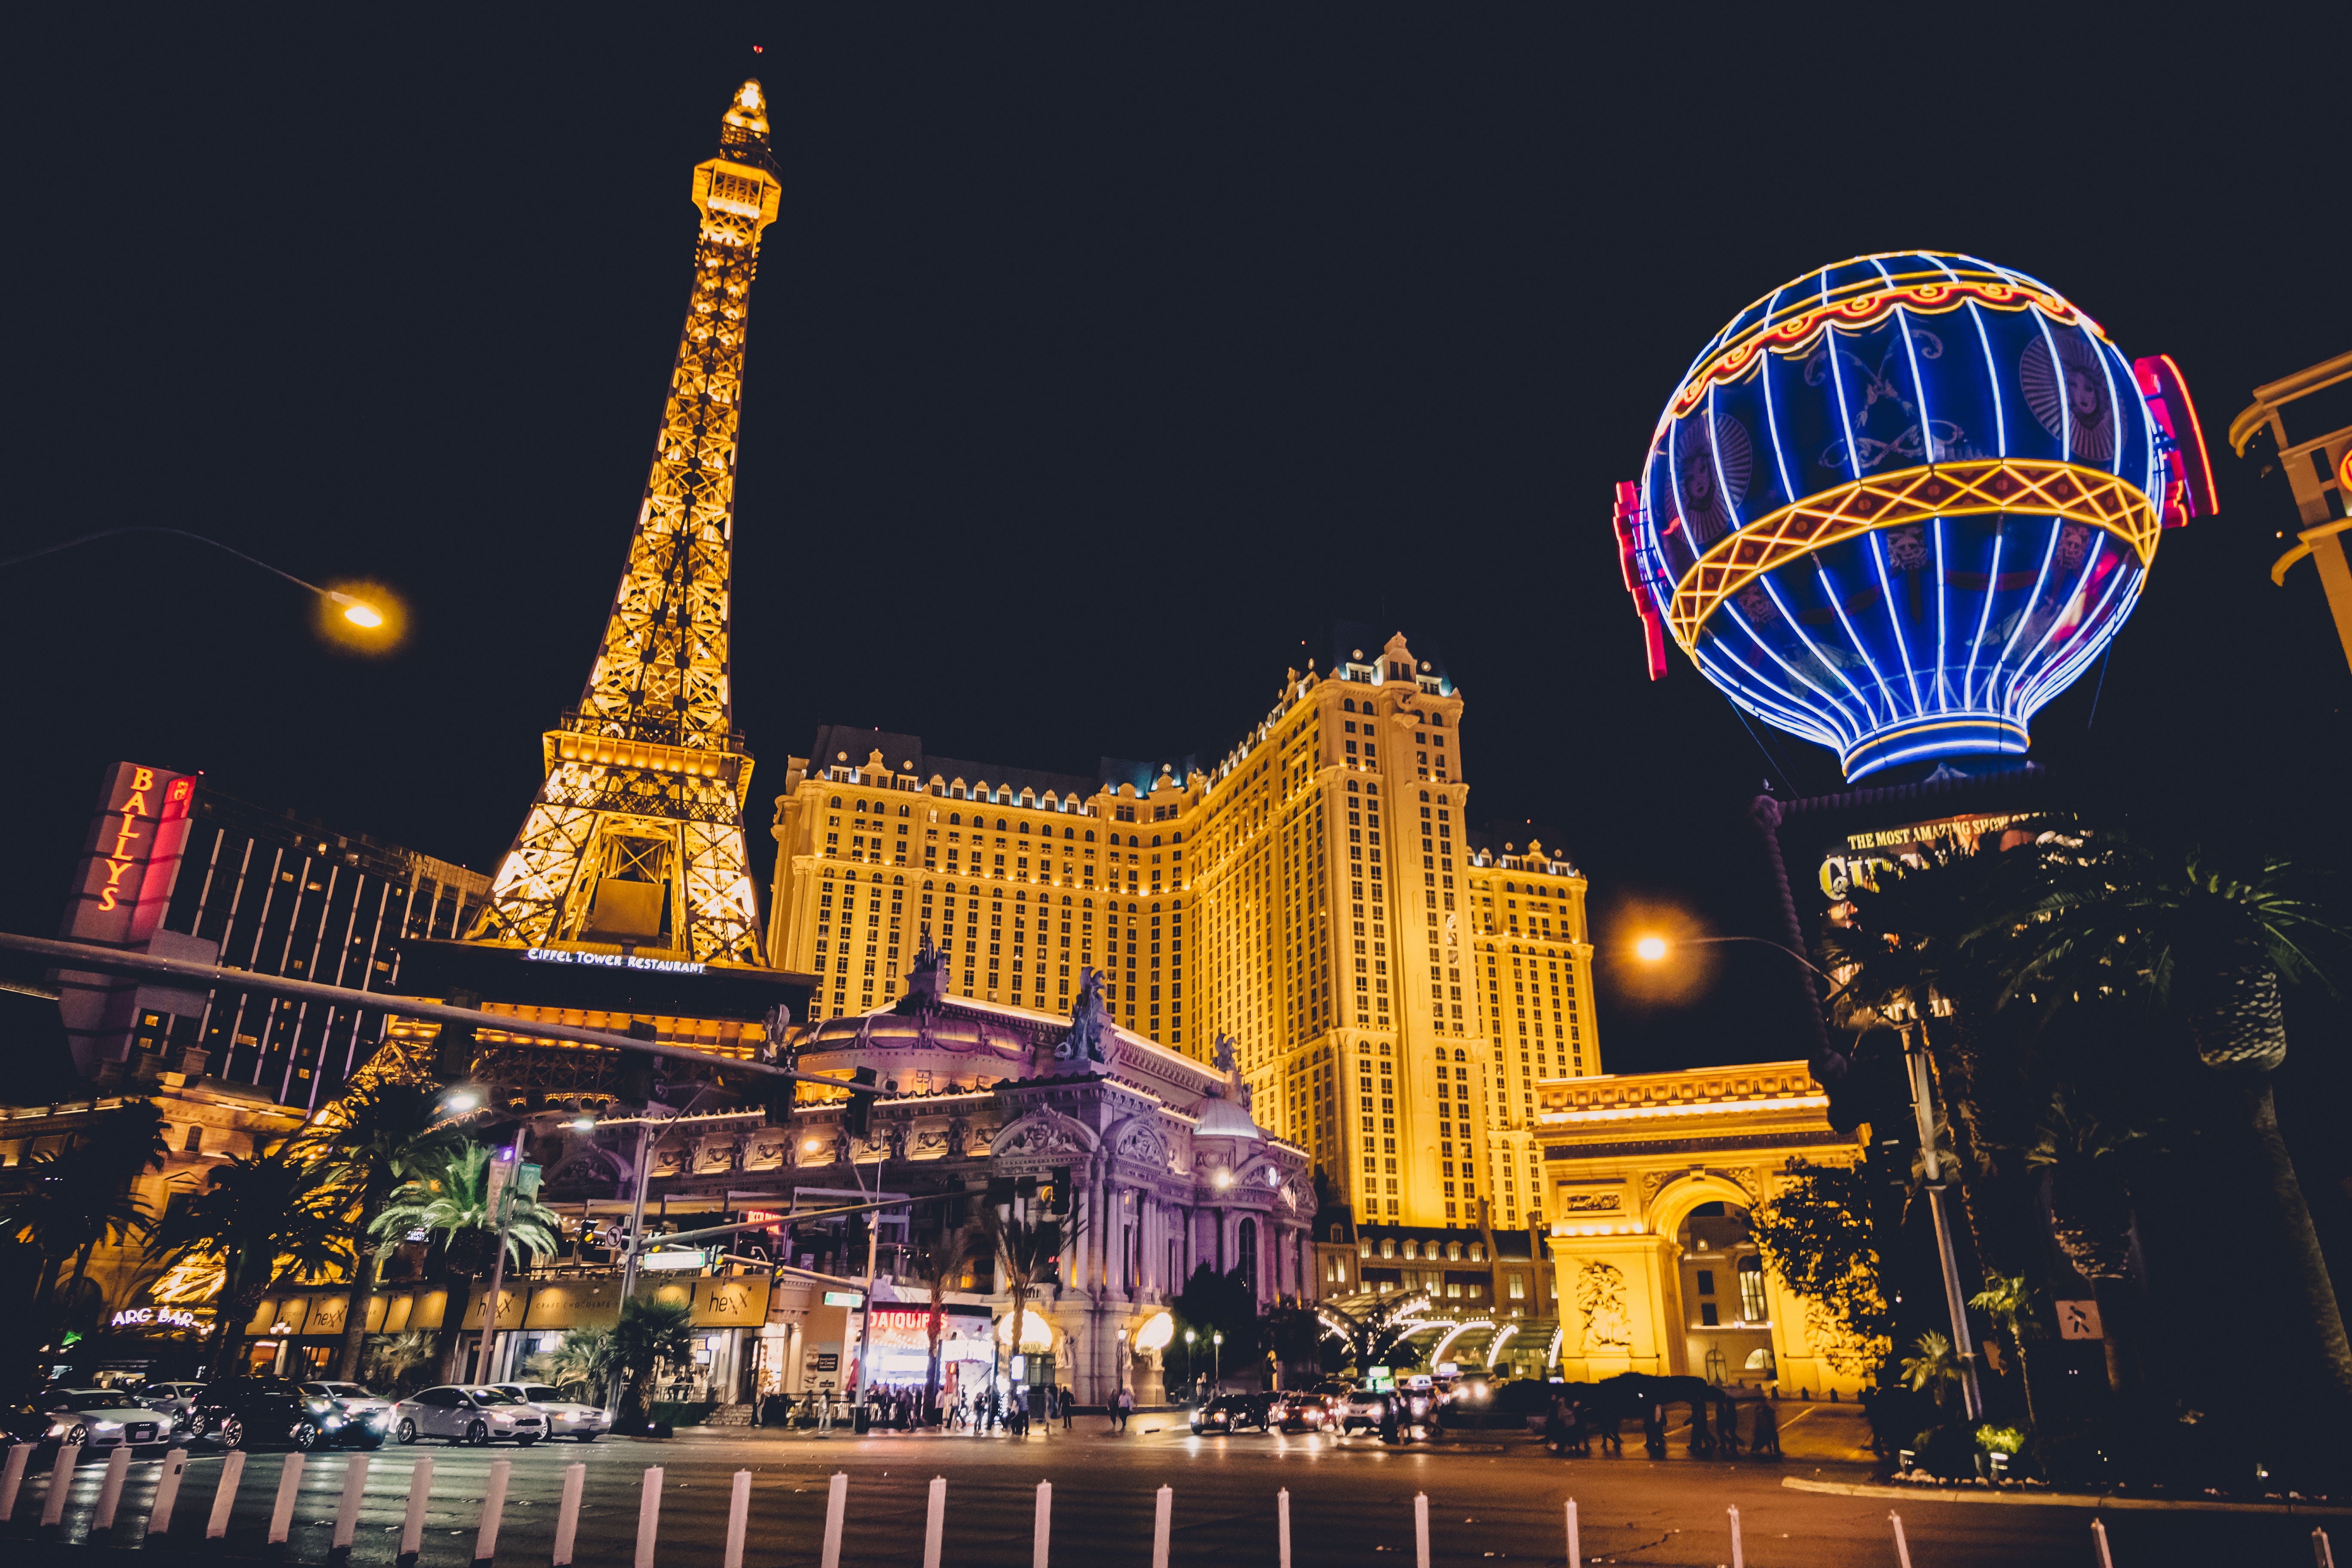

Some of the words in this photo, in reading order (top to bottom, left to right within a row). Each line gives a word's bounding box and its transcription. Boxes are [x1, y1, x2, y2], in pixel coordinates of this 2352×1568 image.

[98, 767, 154, 911] BALLYS
[1847, 833, 1875, 850] THE
[1875, 827, 1910, 847] MOST
[1913, 821, 1971, 842] AMAZING
[1972, 815, 2010, 835] SHOW
[527, 947, 572, 962] EIFFEL
[576, 951, 622, 966] TOWER
[627, 956, 706, 974] RESTAURANT
[477, 1296, 512, 1319] hxx
[708, 1291, 748, 1315] hexx
[111, 1308, 153, 1327] ARG
[157, 1308, 194, 1328] BAR
[313, 1307, 344, 1328] hexx
[870, 1311, 949, 1329] DAIQUIRS
